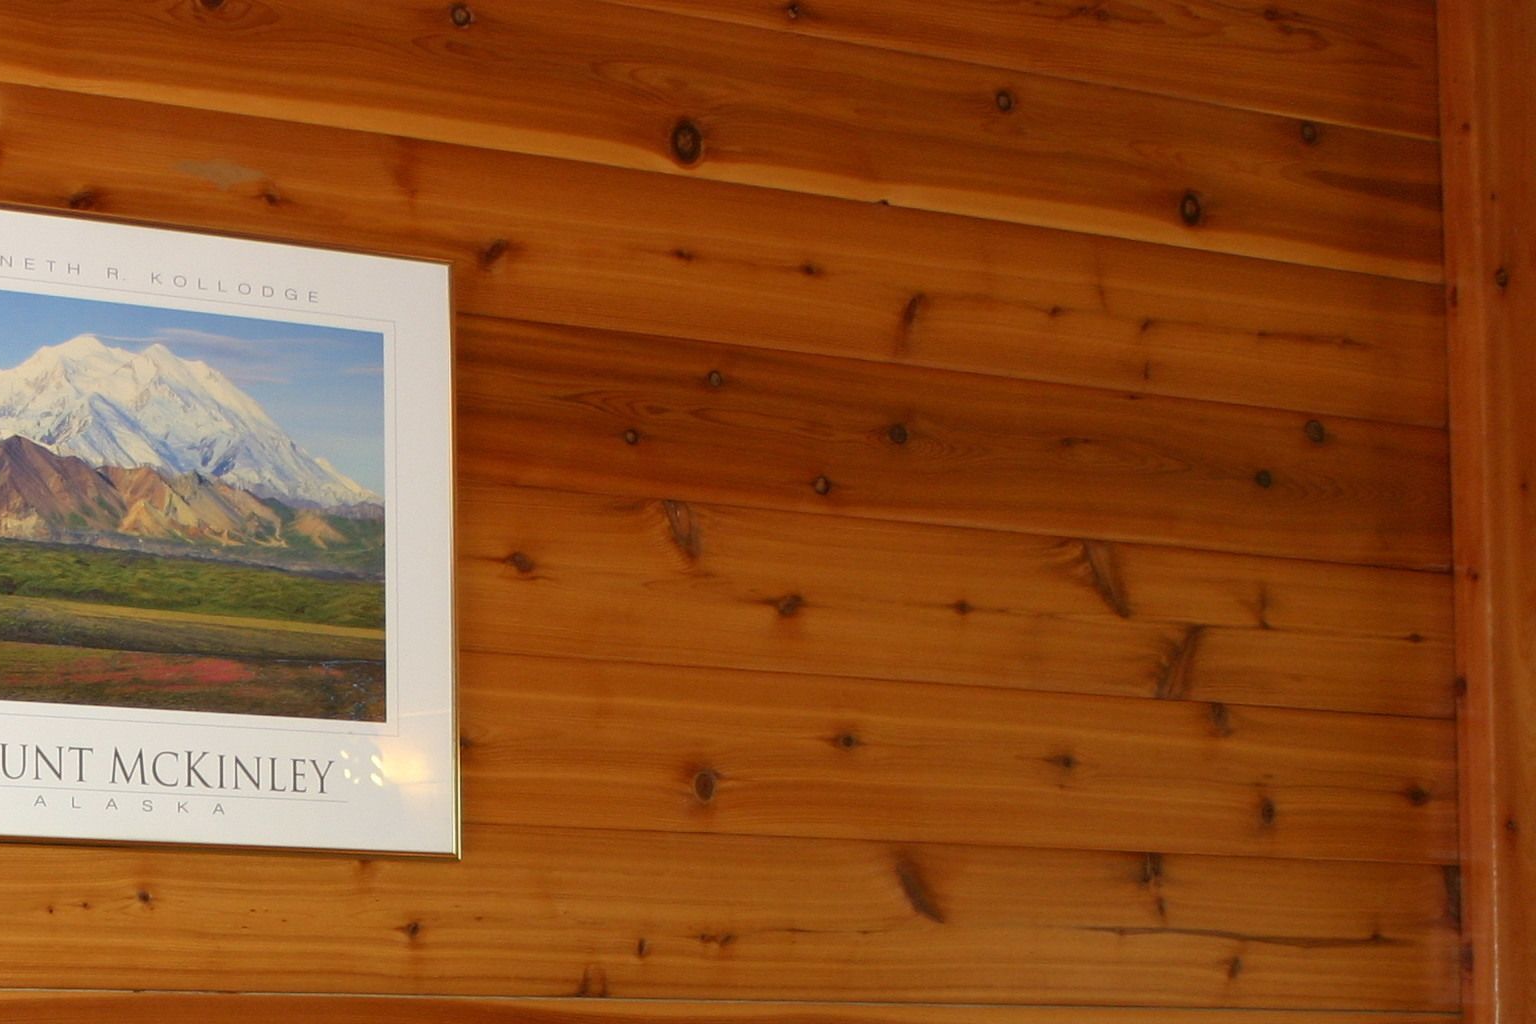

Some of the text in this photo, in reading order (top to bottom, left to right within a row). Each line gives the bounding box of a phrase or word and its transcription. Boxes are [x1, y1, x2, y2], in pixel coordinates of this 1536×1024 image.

[106, 266, 126, 281] R.
[151, 271, 320, 303] KOLLODGE
[108, 746, 335, 795] MCKINLEY
[33, 794, 226, 816] ALASKA
